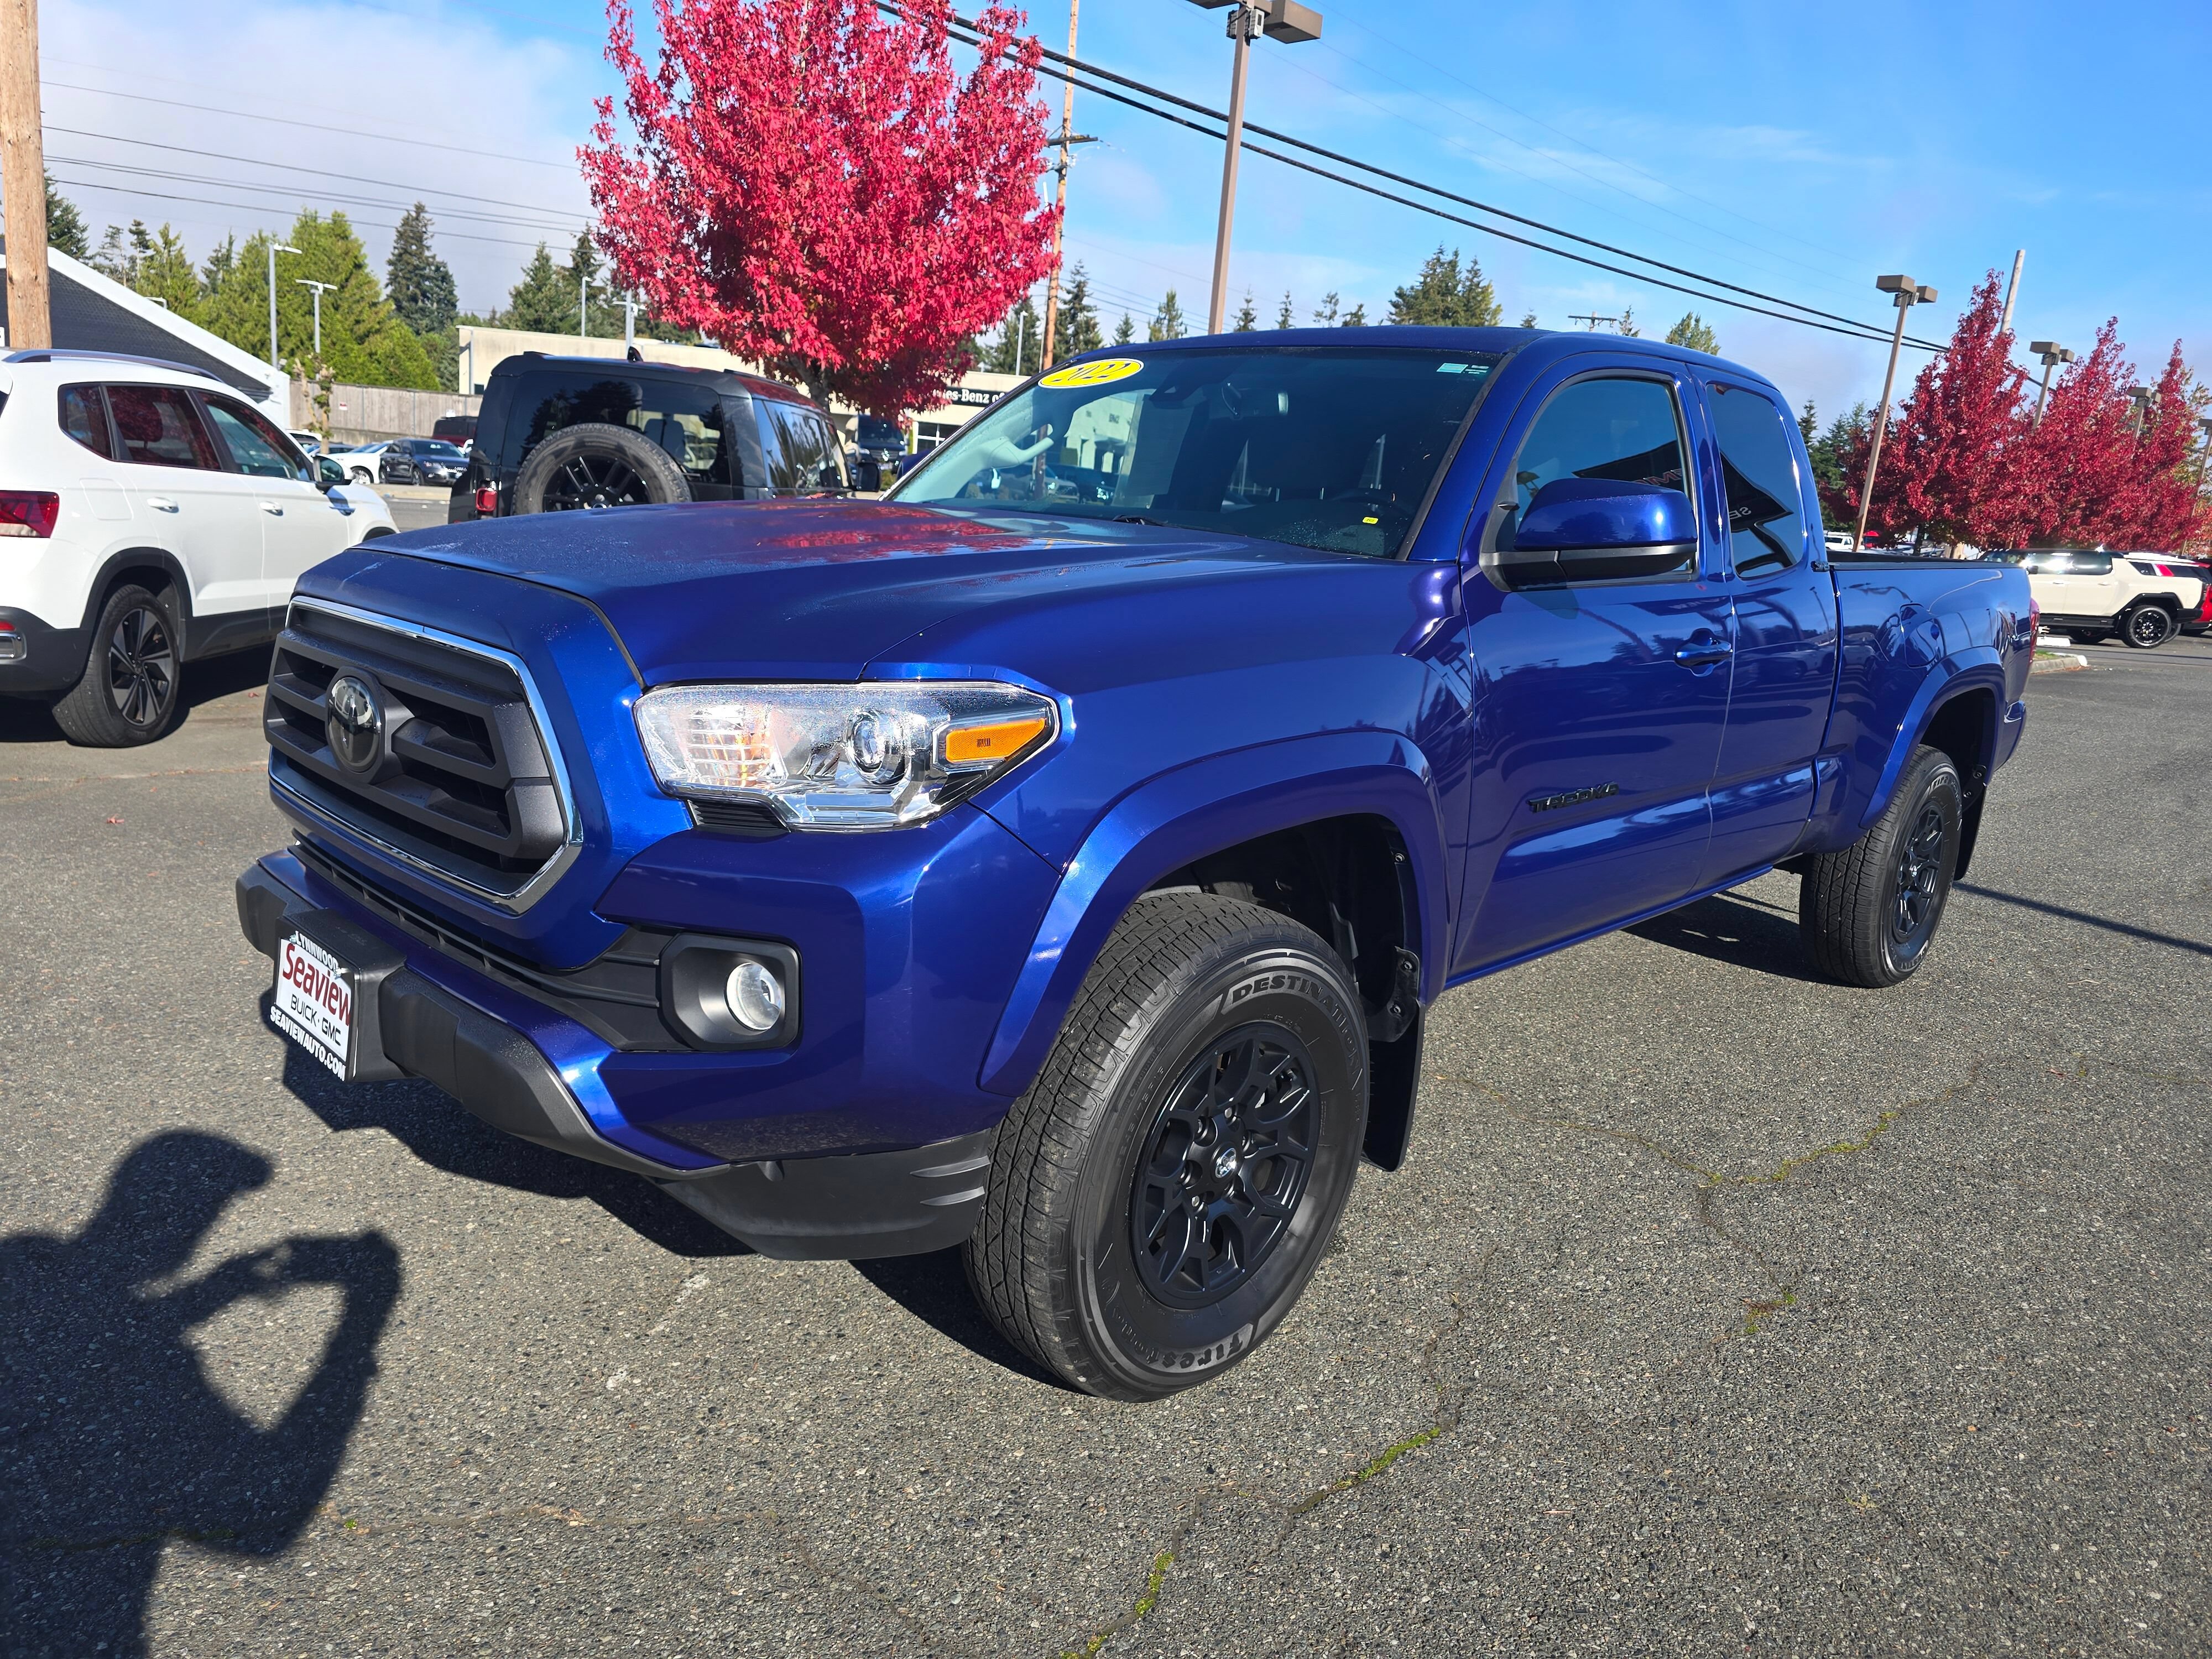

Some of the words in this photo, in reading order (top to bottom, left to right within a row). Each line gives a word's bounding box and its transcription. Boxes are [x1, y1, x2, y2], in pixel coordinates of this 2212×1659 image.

[1050, 362, 1131, 382] 2022
[1526, 780, 1620, 813] TACOMA
[295, 931, 339, 971] LYNNWOOD
[283, 943, 352, 1026] Seaview
[270, 1005, 346, 1082] SEAVIEWAUTO.COM
[290, 994, 316, 1027] BUICK
[321, 1017, 341, 1046] GMC
[1232, 975, 1361, 1075] DESTINATION
